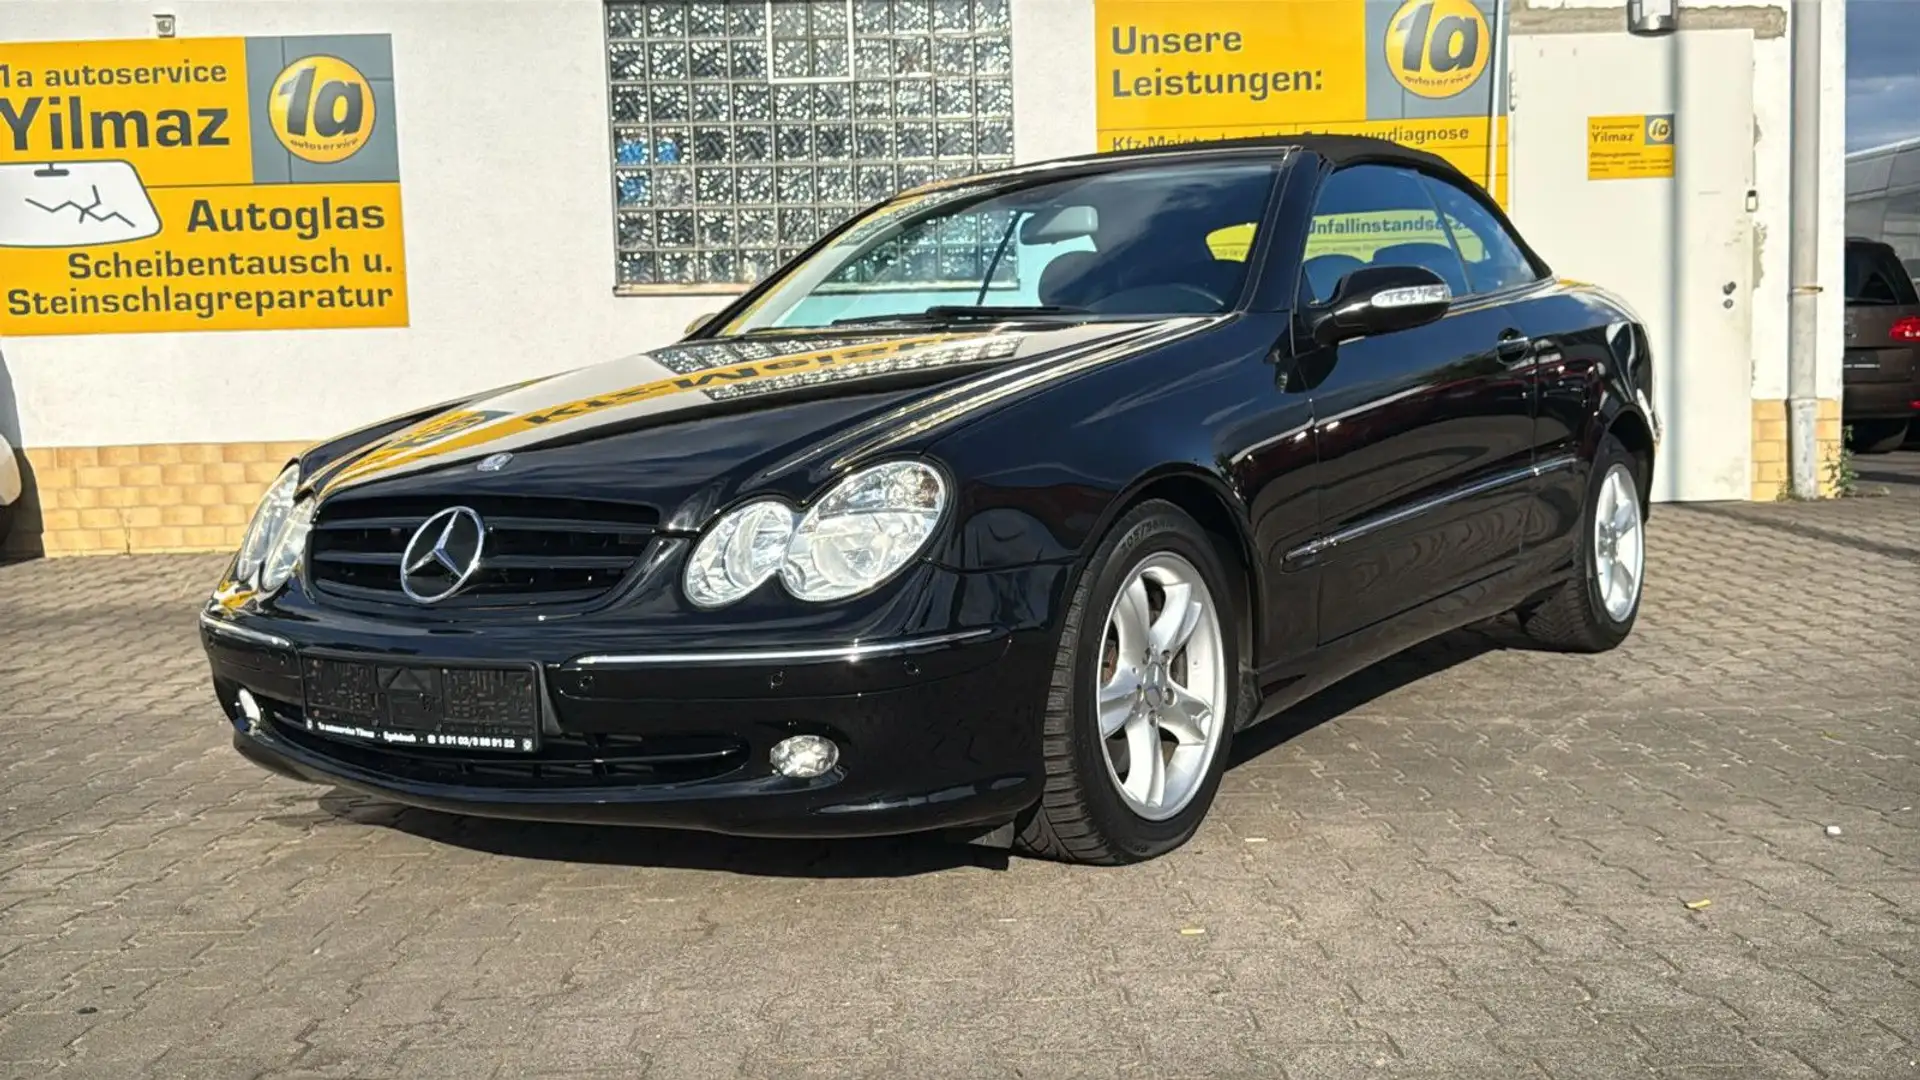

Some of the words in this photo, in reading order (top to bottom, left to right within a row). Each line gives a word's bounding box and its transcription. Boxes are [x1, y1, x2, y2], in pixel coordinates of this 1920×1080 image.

[1112, 26, 1242, 55] Unsere
[1396, 1, 1479, 73] 1a
[0, 64, 33, 88] 1a
[45, 59, 227, 87] autoservice
[1112, 68, 1323, 101] Leistungen:
[279, 66, 364, 138] 1a
[0, 95, 230, 151] Yilmaz
[187, 196, 385, 240] Autoglas
[68, 247, 350, 281] Scheibentausch
[363, 254, 393, 274] u.
[8, 284, 393, 319] Steinschlagreparatur
